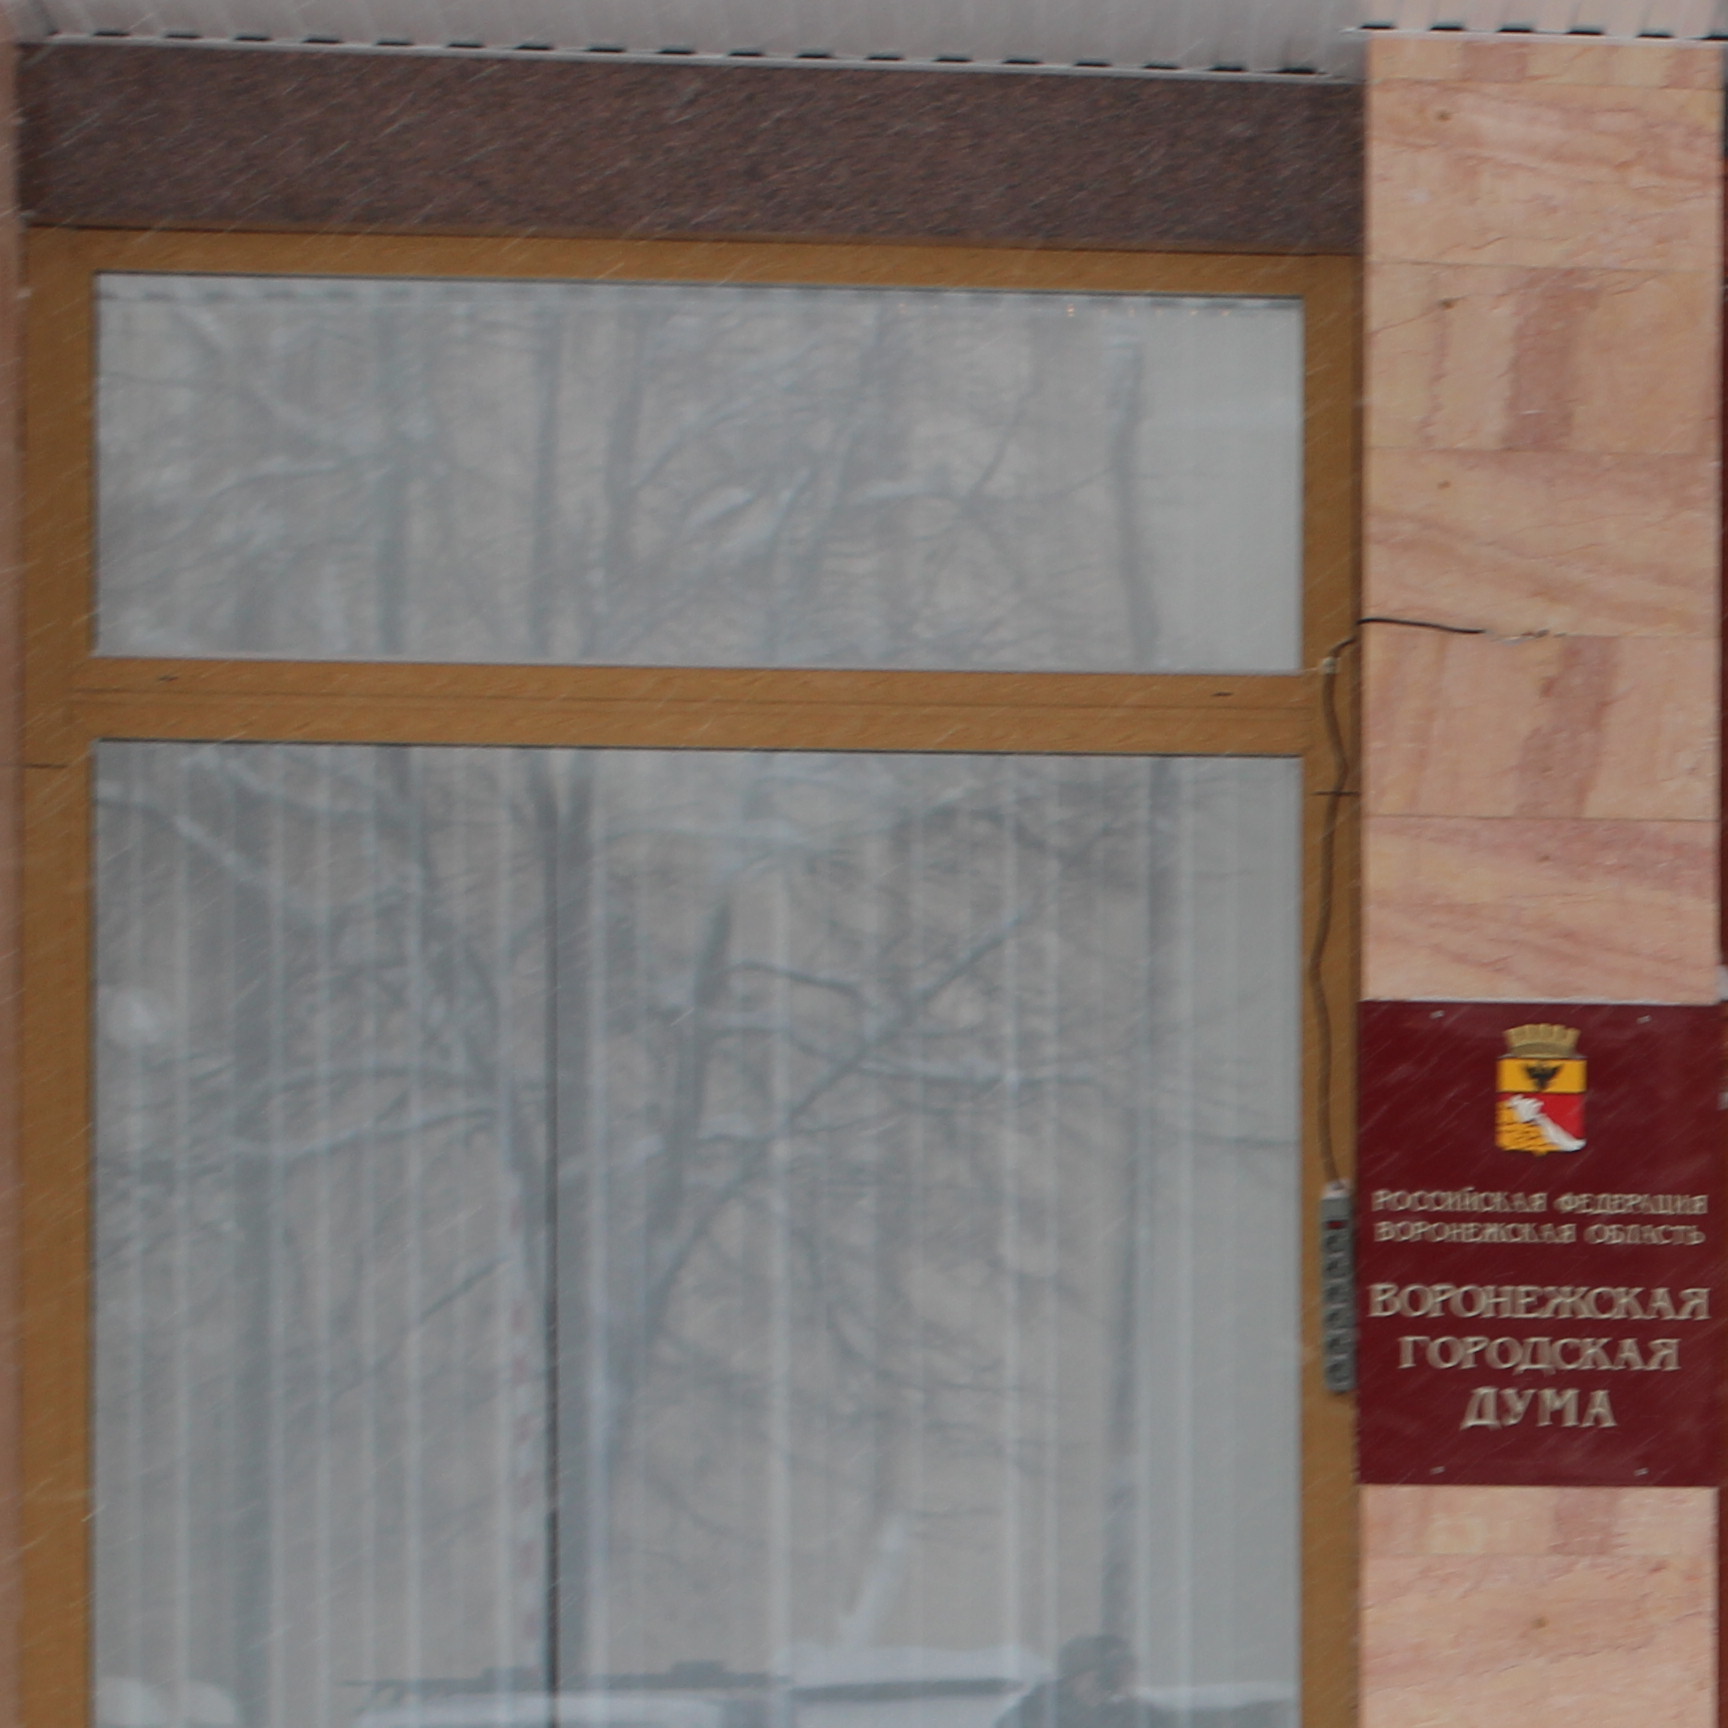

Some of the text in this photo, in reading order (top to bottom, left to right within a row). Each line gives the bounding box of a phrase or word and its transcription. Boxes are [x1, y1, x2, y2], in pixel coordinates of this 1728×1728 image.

[1372, 1187, 1708, 1215] РОССИЙСКАЯ ФЕДЕРАЦИЯ
[1375, 1221, 1706, 1245] ВОРОНЕЖСКАЯ ОБЛАСТЬ
[1368, 1283, 1711, 1320] ВОРОНЕЖСКАЯ
[1398, 1336, 1681, 1375] ГОРОДСКАЯ
[1460, 1386, 1617, 1430] ДУМА
